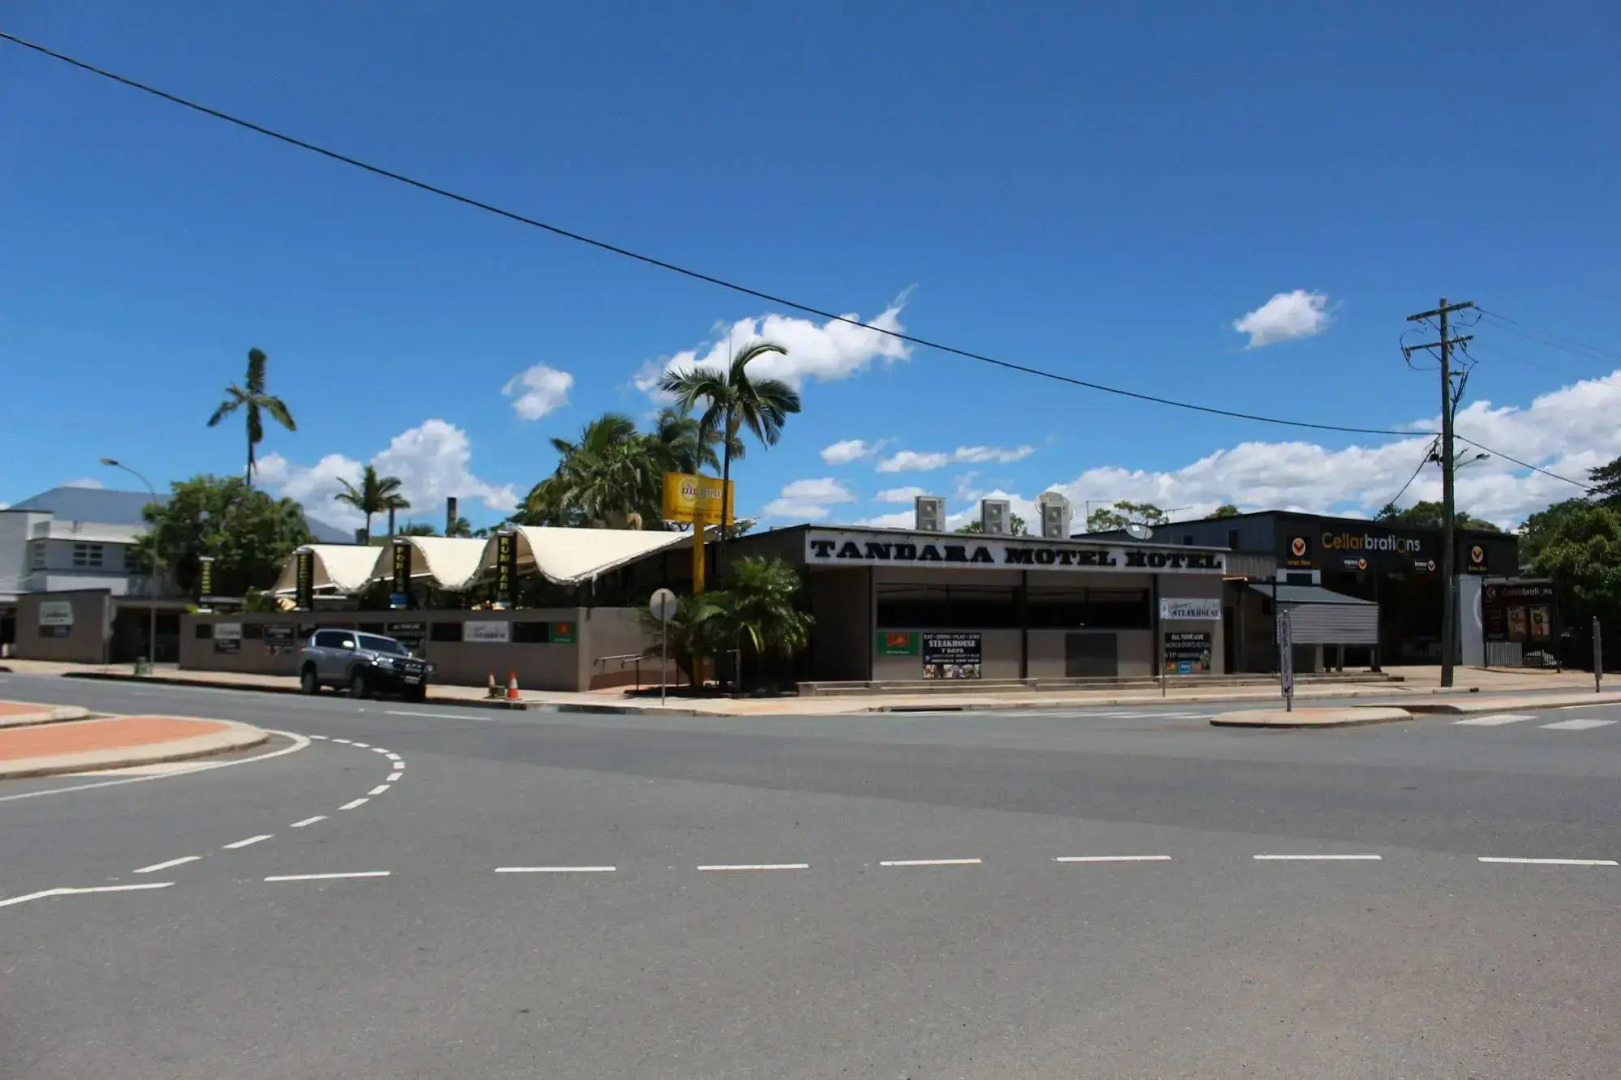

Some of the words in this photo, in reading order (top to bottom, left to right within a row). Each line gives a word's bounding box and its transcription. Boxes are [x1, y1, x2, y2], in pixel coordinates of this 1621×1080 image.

[810, 540, 995, 564] TANDARA
[1004, 547, 1117, 567] MOTEL
[1125, 550, 1223, 570] HOTEL
[1321, 531, 1421, 555] Cellarbrations
[928, 640, 977, 648] STEAKHOUSE
